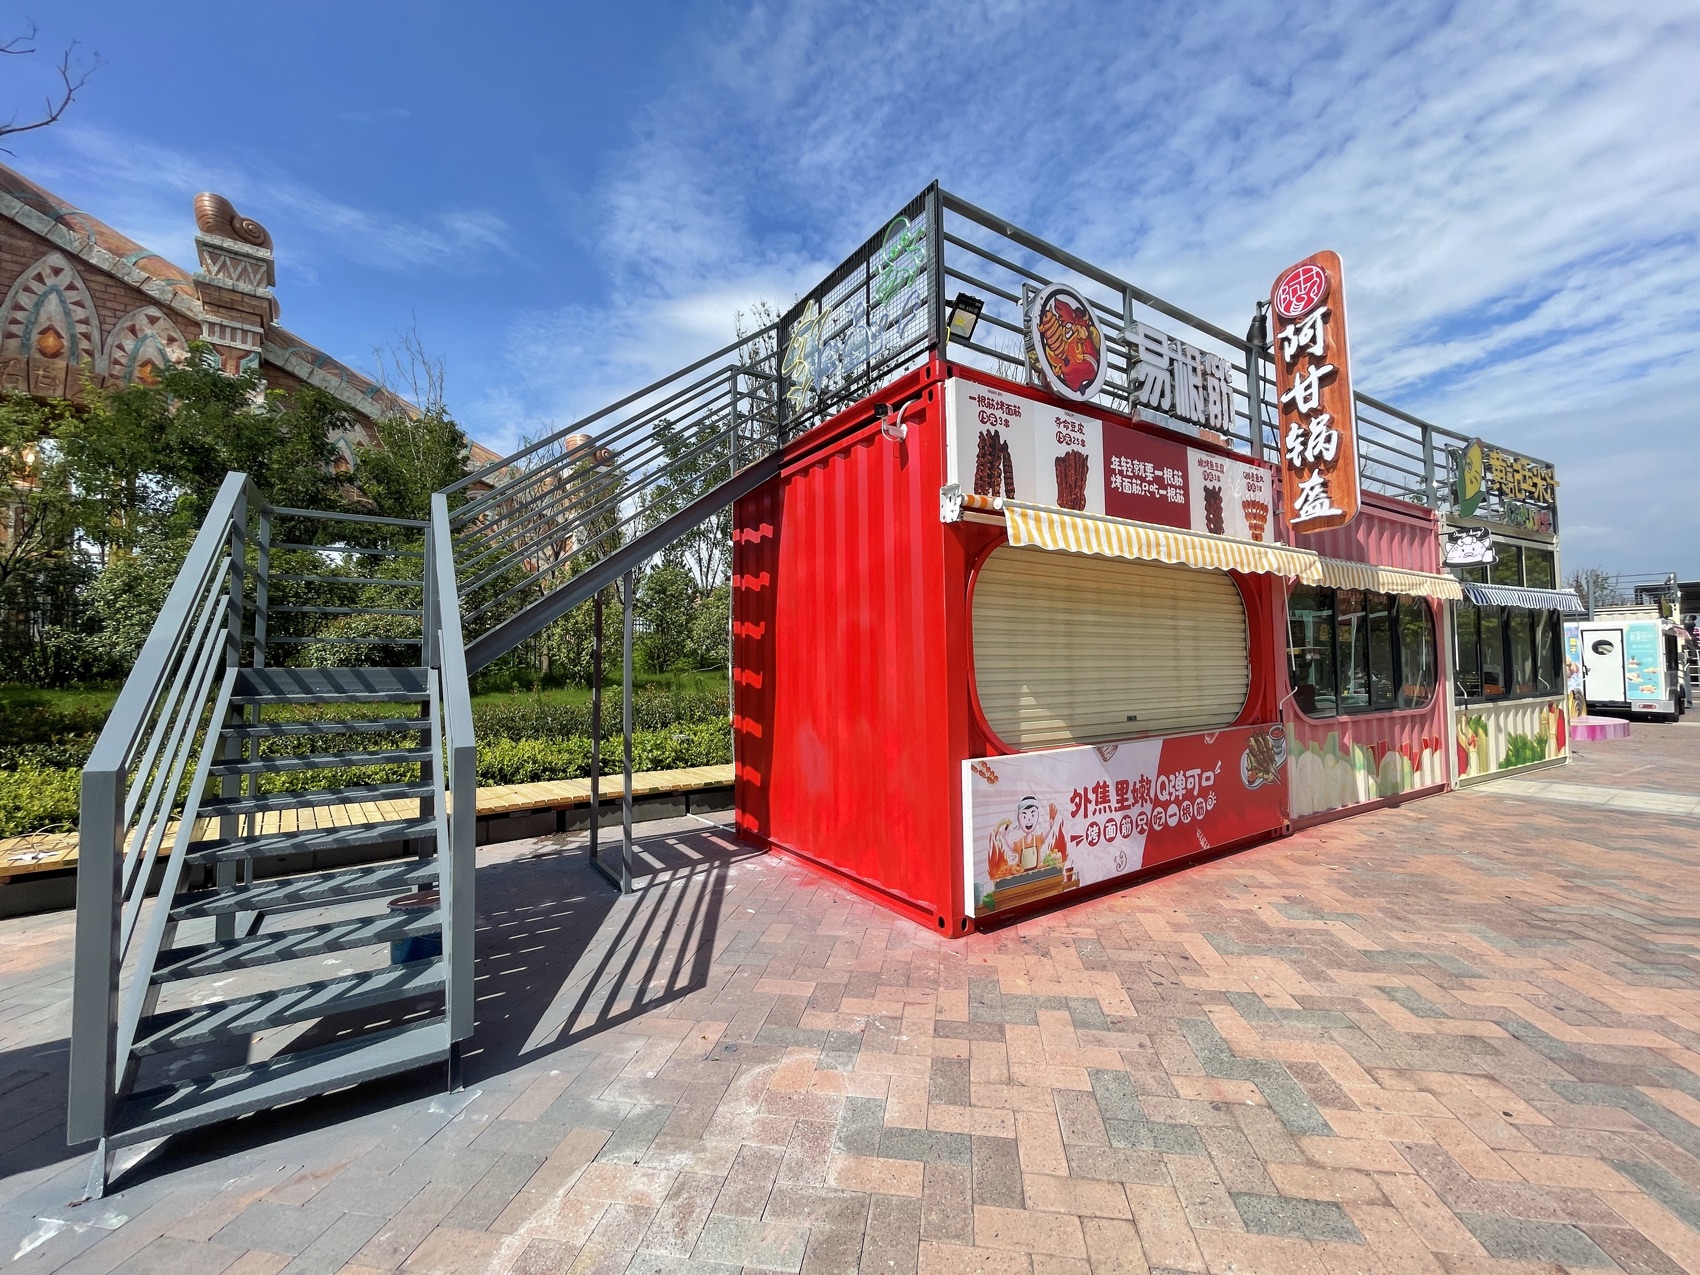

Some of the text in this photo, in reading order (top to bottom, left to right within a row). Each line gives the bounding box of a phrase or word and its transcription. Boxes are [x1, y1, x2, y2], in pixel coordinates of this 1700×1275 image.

[969, 394, 1022, 417] 一根筋烤面筋
[1277, 306, 1342, 523] 阿甘锅盔
[1110, 455, 1183, 486] 年轻就要一根筋
[1110, 474, 1185, 504] 烤面筋只吃一根筋
[1086, 798, 1206, 847] 烤面筋只吃一根筋
